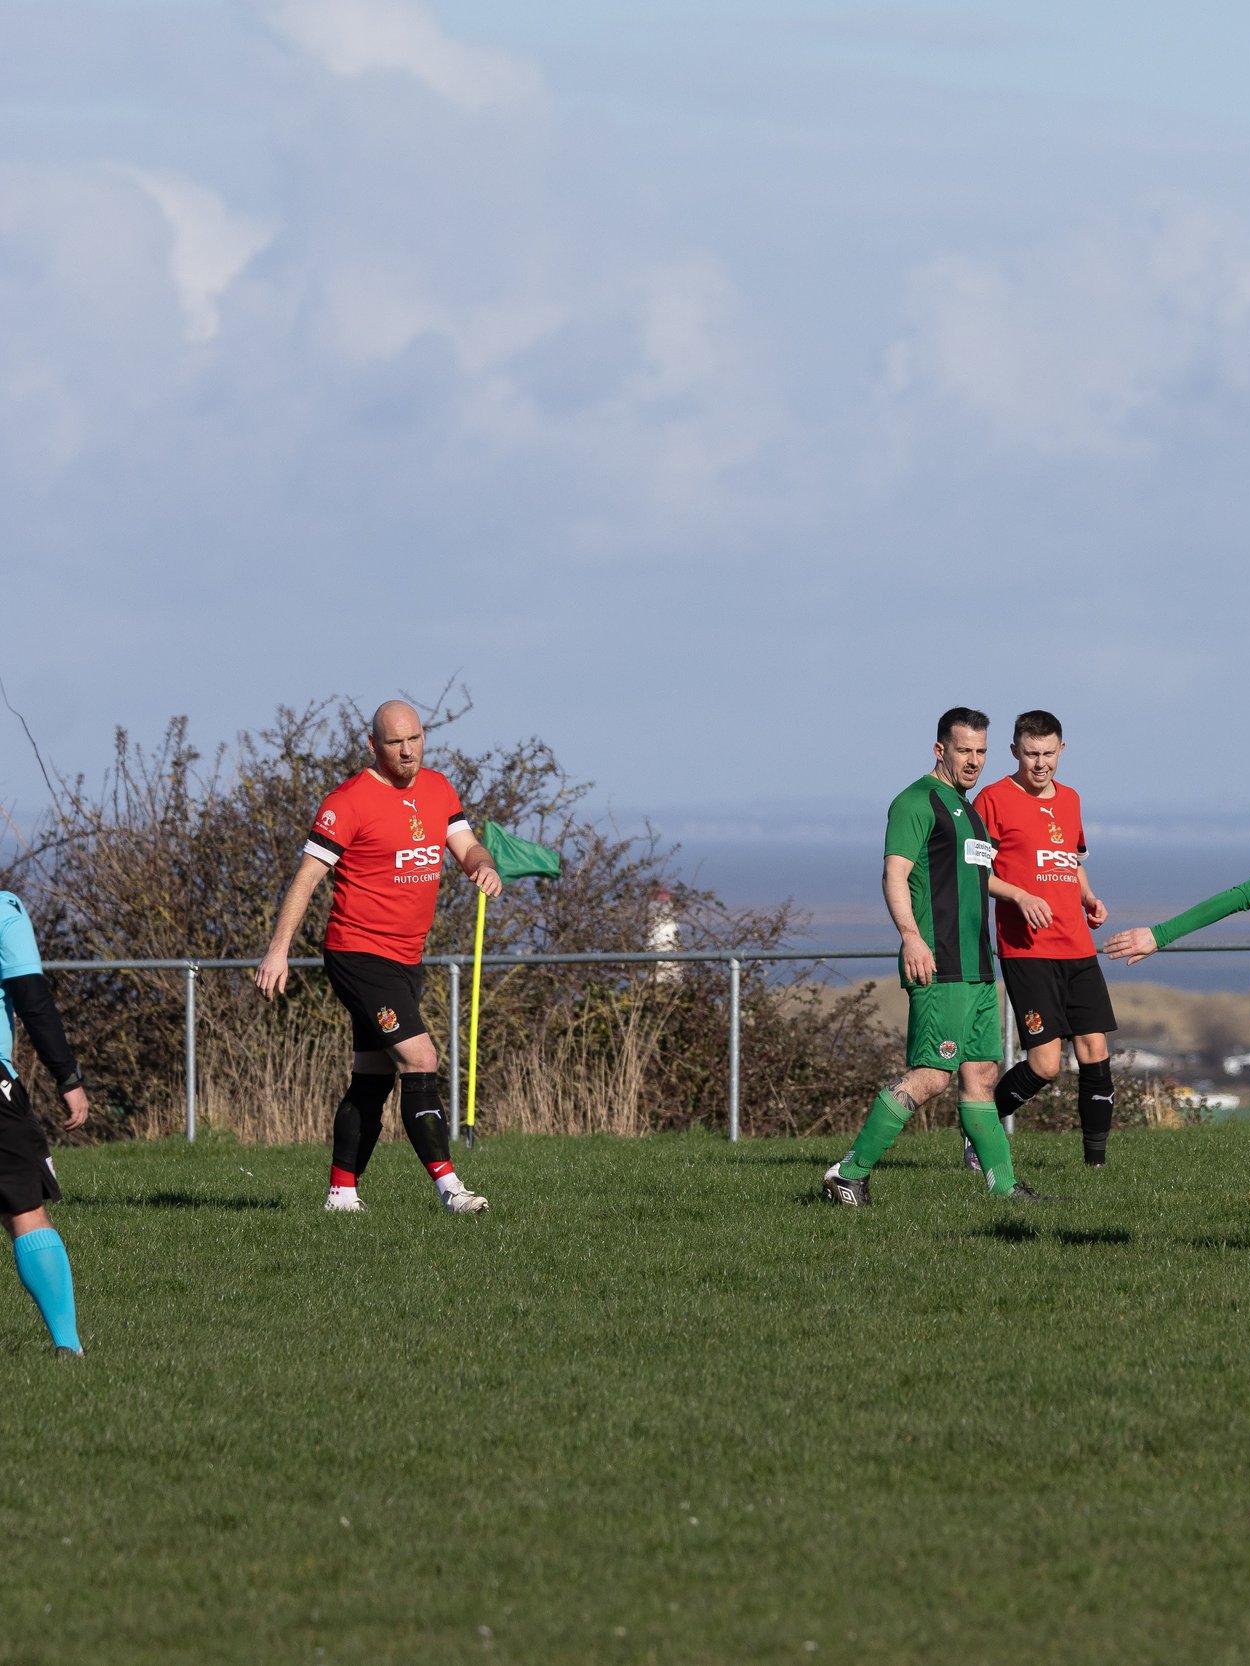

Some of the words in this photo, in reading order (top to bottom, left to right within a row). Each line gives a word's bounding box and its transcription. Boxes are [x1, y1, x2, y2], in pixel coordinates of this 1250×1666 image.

[395, 845, 441, 869] PSS
[1036, 849, 1078, 870] PSS
[394, 875, 420, 884] AUTO
[1036, 873, 1059, 882] AUTO
